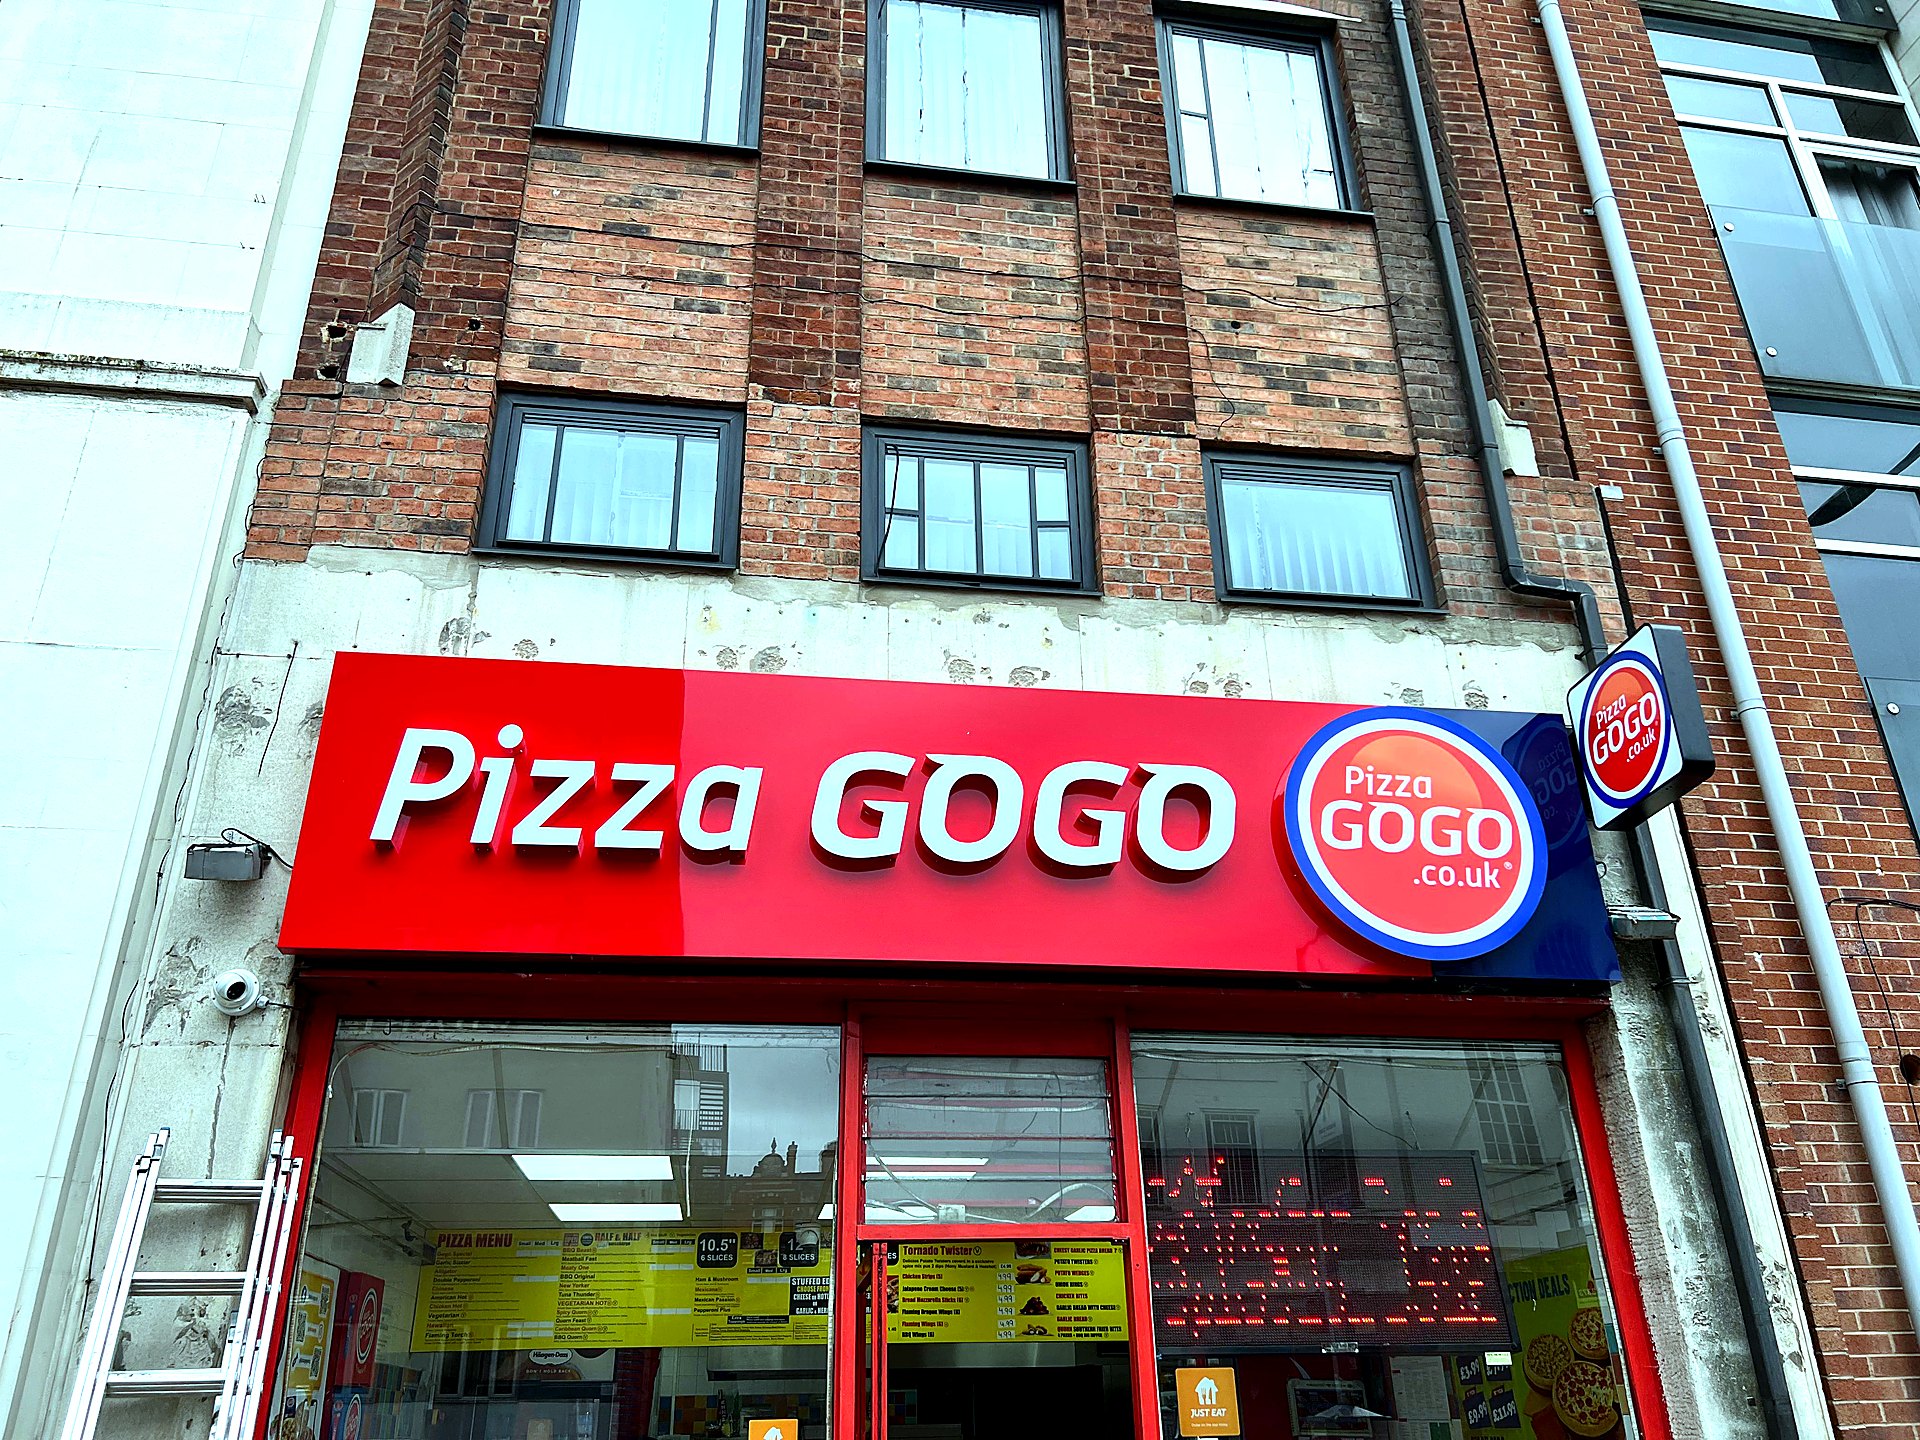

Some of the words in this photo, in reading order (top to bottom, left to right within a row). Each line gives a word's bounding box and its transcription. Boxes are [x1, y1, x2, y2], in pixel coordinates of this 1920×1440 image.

[1595, 694, 1627, 729] Pizza
[1592, 691, 1657, 765] GOGO
[1626, 727, 1657, 763] .co.uk
[1345, 765, 1432, 798] Pizza
[369, 724, 764, 856] Pizza
[810, 750, 1237, 874] GOGO
[1321, 799, 1513, 859] GOGO
[1413, 861, 1501, 889] .co.uk
[437, 1233, 473, 1248] PIZZA
[475, 1233, 513, 1248] MENU
[595, 1233, 613, 1241] HALF
[622, 1232, 641, 1241] HALF
[700, 1238, 736, 1252] 10.5"
[903, 1246, 939, 1256] Tornado
[940, 1246, 973, 1256] Twister
[791, 1277, 821, 1286] STUFFED
[1537, 1273, 1571, 1299] DEALS
[1460, 1358, 1480, 1381] £3.99
[1190, 1408, 1210, 1419] JUST
[1211, 1408, 1227, 1417] EAT
[1467, 1401, 1488, 1425] £9.99
[1492, 1400, 1516, 1423] £11.99
